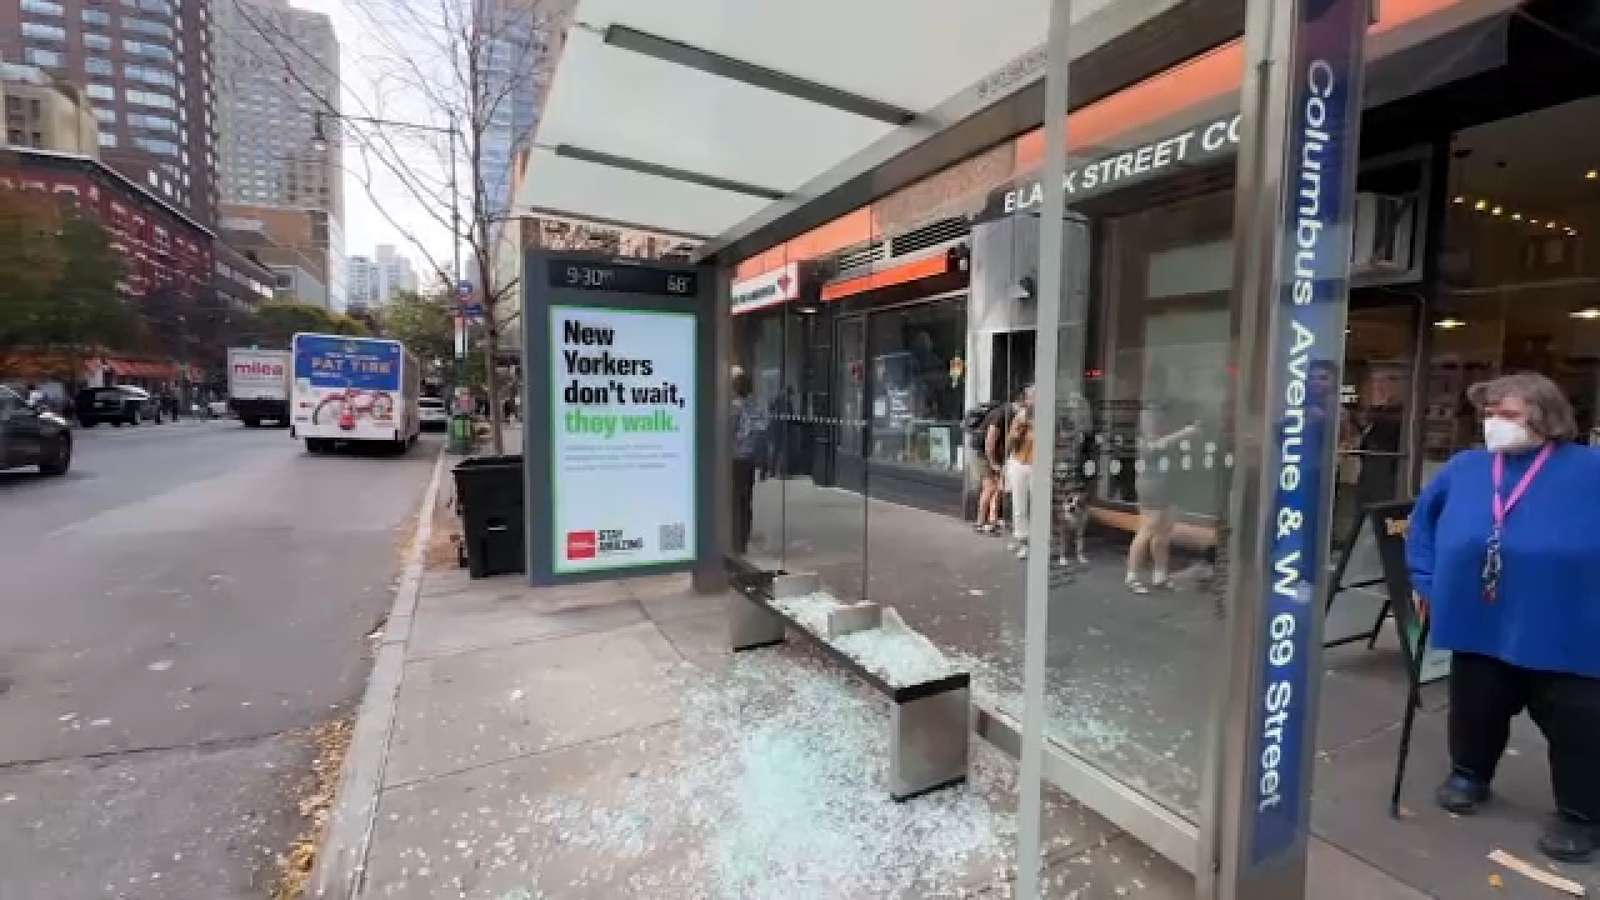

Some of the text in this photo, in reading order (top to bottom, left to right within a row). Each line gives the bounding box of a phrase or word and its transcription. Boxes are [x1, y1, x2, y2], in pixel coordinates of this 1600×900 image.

[1004, 170, 1078, 213] BLAK
[1081, 129, 1195, 189] STREET
[564, 319, 615, 345] New
[564, 349, 654, 375] Yorkers
[564, 380, 686, 409] don't wait,
[565, 410, 680, 440] they walk.
[1258, 59, 1334, 813] Columbus Avenue & W 69 Street
